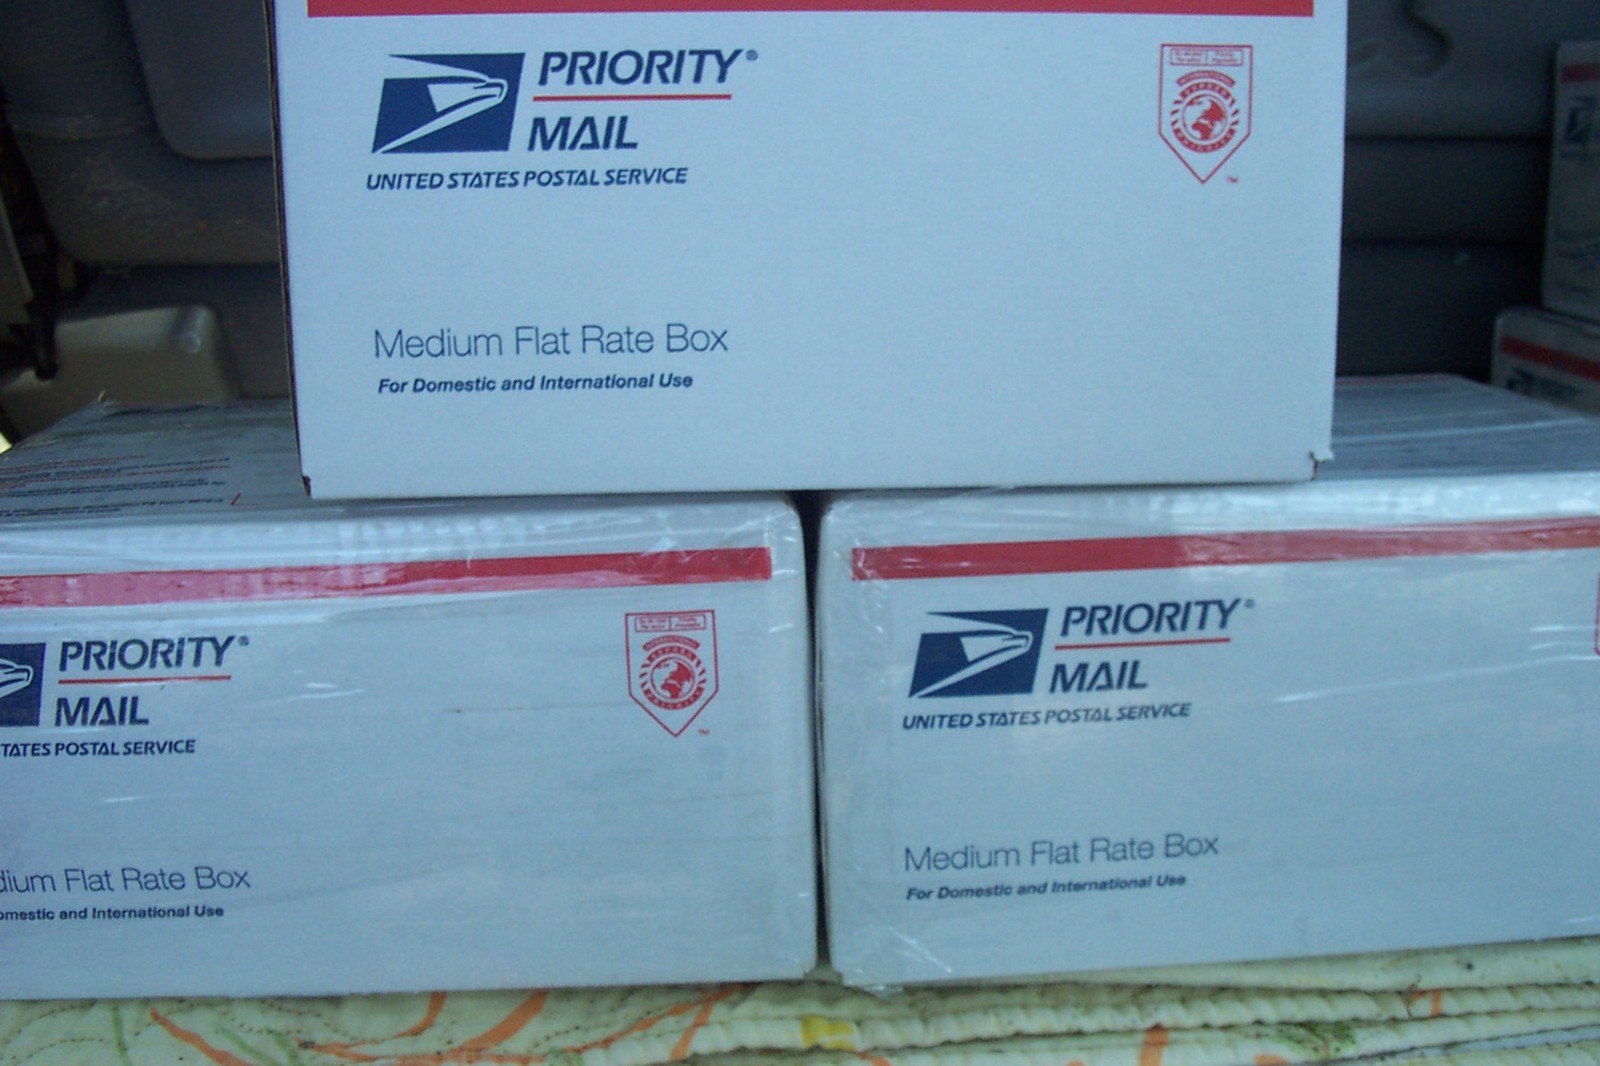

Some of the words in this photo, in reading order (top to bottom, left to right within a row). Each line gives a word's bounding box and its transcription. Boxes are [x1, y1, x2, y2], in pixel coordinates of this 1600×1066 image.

[528, 115, 638, 152] MAIL
[367, 172, 443, 191] UNITED
[447, 171, 520, 189] STATES
[523, 169, 600, 187] POSTAL
[604, 167, 688, 186] SERVICE
[375, 328, 503, 358] Medium
[515, 326, 571, 355] Flat
[581, 324, 654, 354] Rate
[666, 323, 728, 352] Box
[378, 378, 408, 394] For
[412, 376, 496, 392] Domestic
[501, 375, 535, 391] and
[540, 373, 654, 391] International
[659, 373, 693, 388] Use
[1048, 660, 1147, 694] MAIL
[54, 695, 149, 727] MAIL
[902, 713, 973, 730] UNITED
[976, 710, 1041, 727] STATES
[1044, 708, 1113, 725] POSTAL
[1116, 702, 1192, 720] SERVICE
[54, 742, 120, 756] POSTAL
[123, 739, 196, 755] SERVICE
[904, 845, 1020, 871] Medium
[1031, 840, 1080, 866] Flat
[1090, 837, 1154, 863] Rate
[1164, 833, 1219, 859] Box
[64, 868, 114, 892] Flat
[121, 867, 186, 891] Rate
[194, 866, 251, 890] Box
[906, 887, 933, 901] For
[937, 884, 1012, 900] Domestic
[1017, 881, 1048, 896] and
[1051, 875, 1153, 894] International
[1156, 874, 1186, 888] Use
[59, 906, 88, 921] and
[92, 905, 190, 920] International
[194, 905, 224, 919] Use
